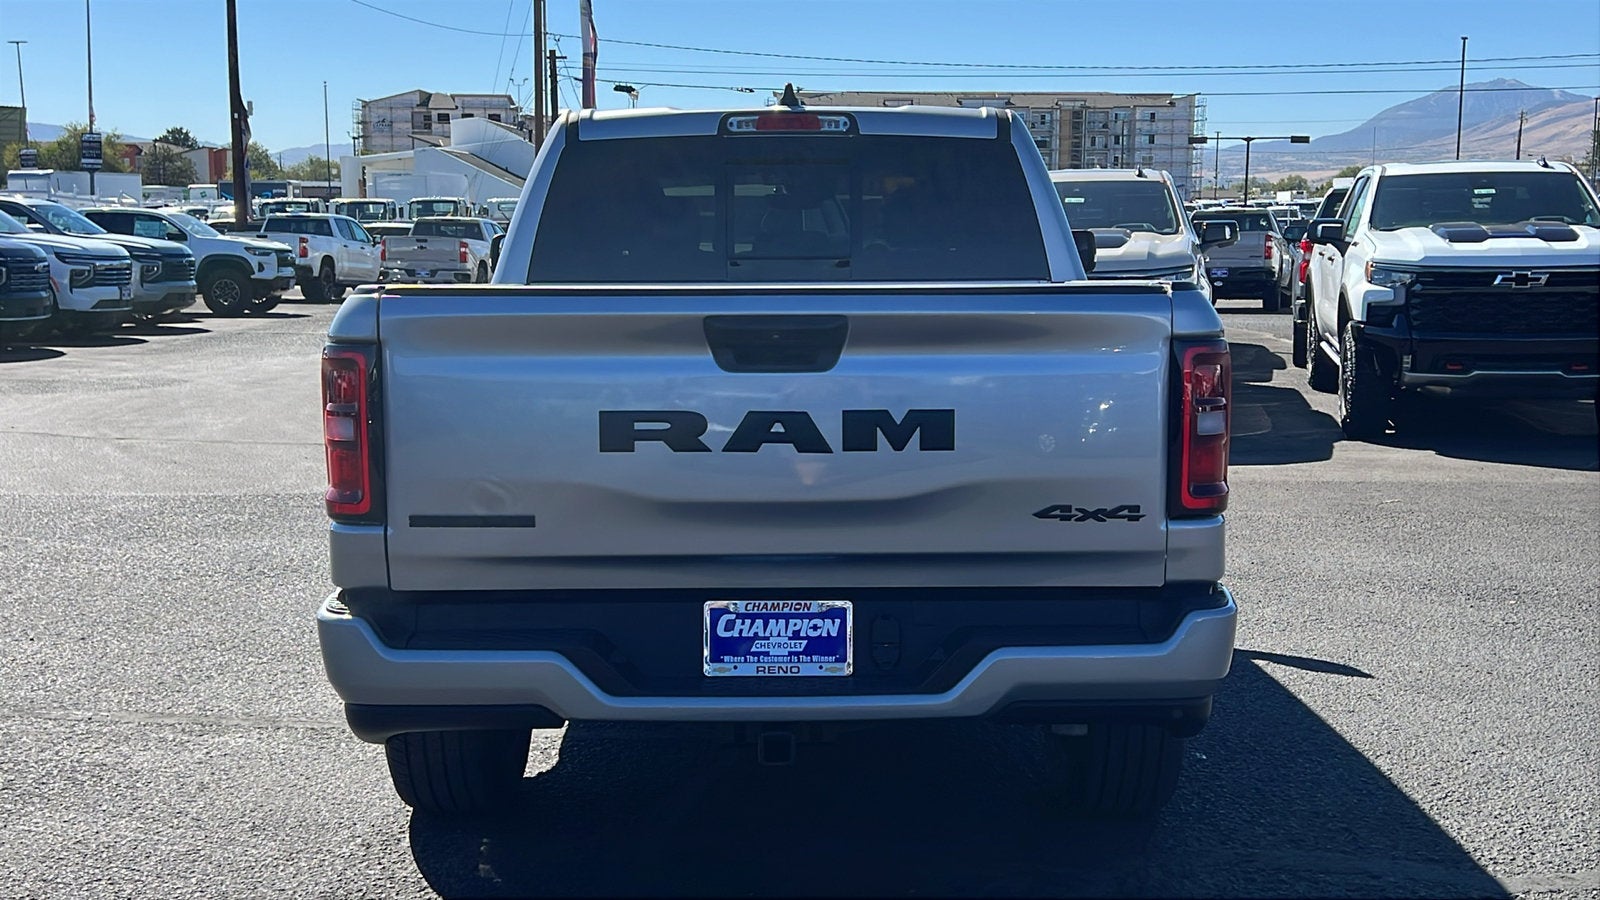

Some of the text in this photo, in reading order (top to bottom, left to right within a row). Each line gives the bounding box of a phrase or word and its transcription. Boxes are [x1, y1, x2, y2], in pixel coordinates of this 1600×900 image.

[599, 409, 955, 454] RAM
[1032, 504, 1147, 523] 4x4
[744, 601, 812, 612] CHAMPION
[716, 613, 841, 637] CHAMPION
[754, 641, 804, 650] CHEVROLET
[746, 655, 758, 663] The
[760, 655, 791, 663] Customer
[800, 655, 811, 663] The
[756, 665, 800, 674] RENO
